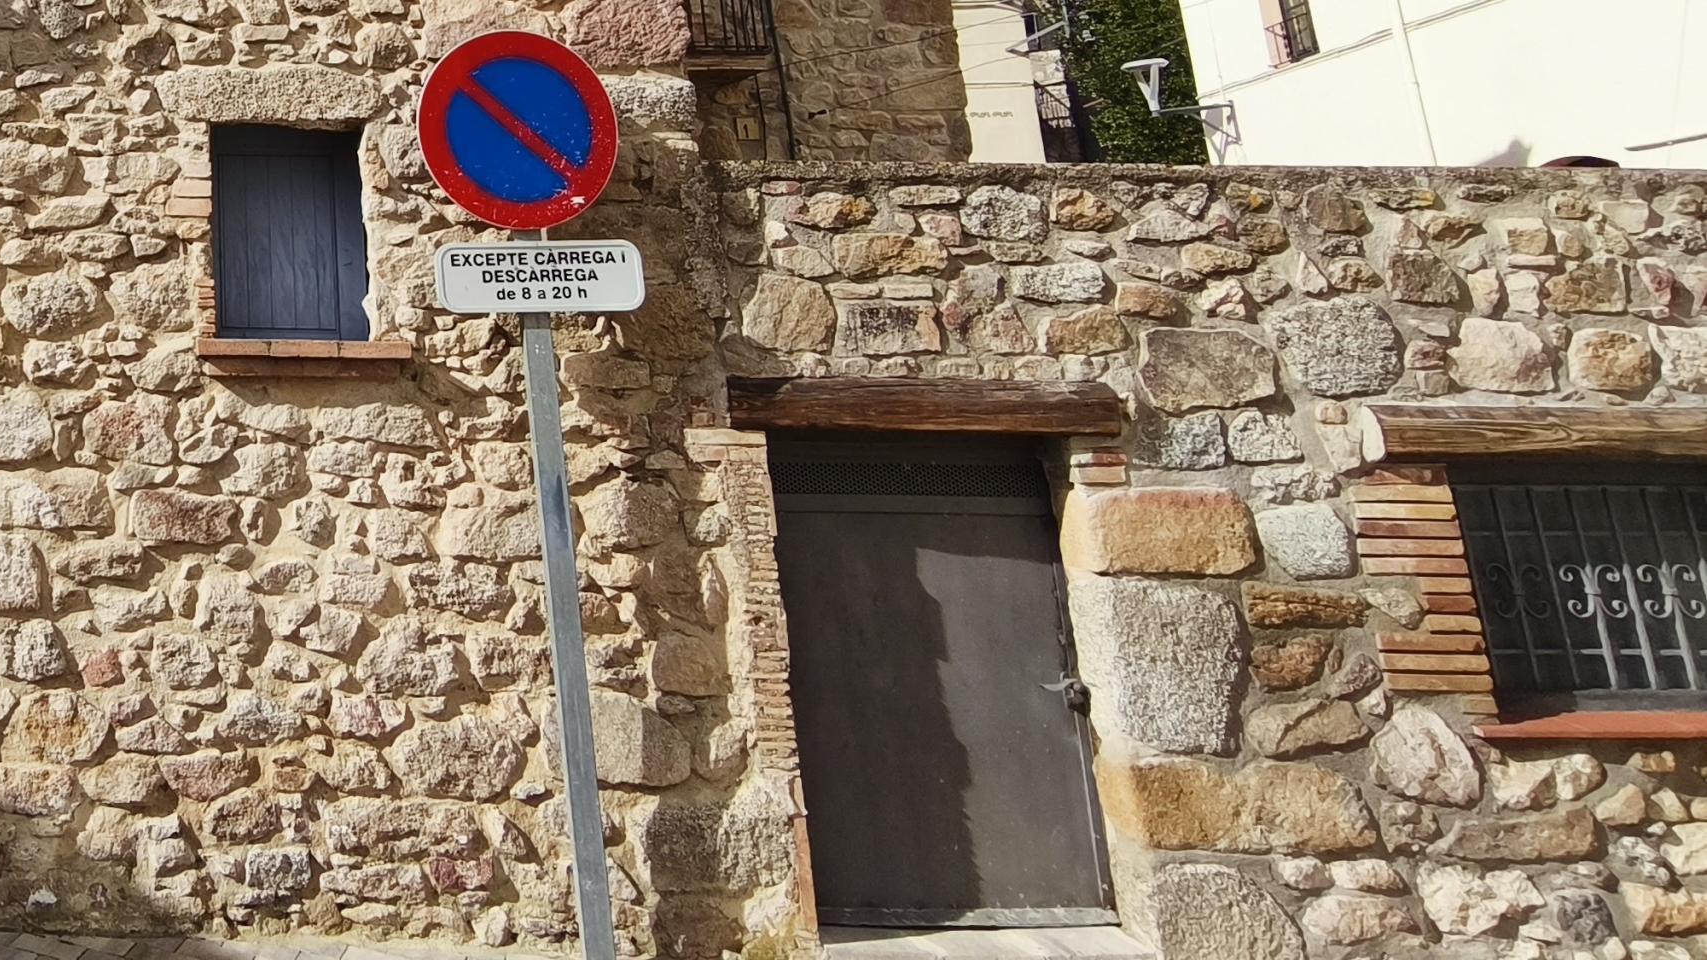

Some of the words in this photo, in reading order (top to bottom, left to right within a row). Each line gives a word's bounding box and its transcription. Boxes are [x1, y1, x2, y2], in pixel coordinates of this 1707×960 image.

[450, 252, 529, 267] EXCEPTE
[534, 248, 617, 266] CÀRREGA
[620, 251, 626, 264] I
[496, 288, 516, 301] de
[521, 286, 532, 300] 8
[537, 289, 547, 300] a
[551, 286, 572, 300] 20
[577, 285, 588, 299] h
